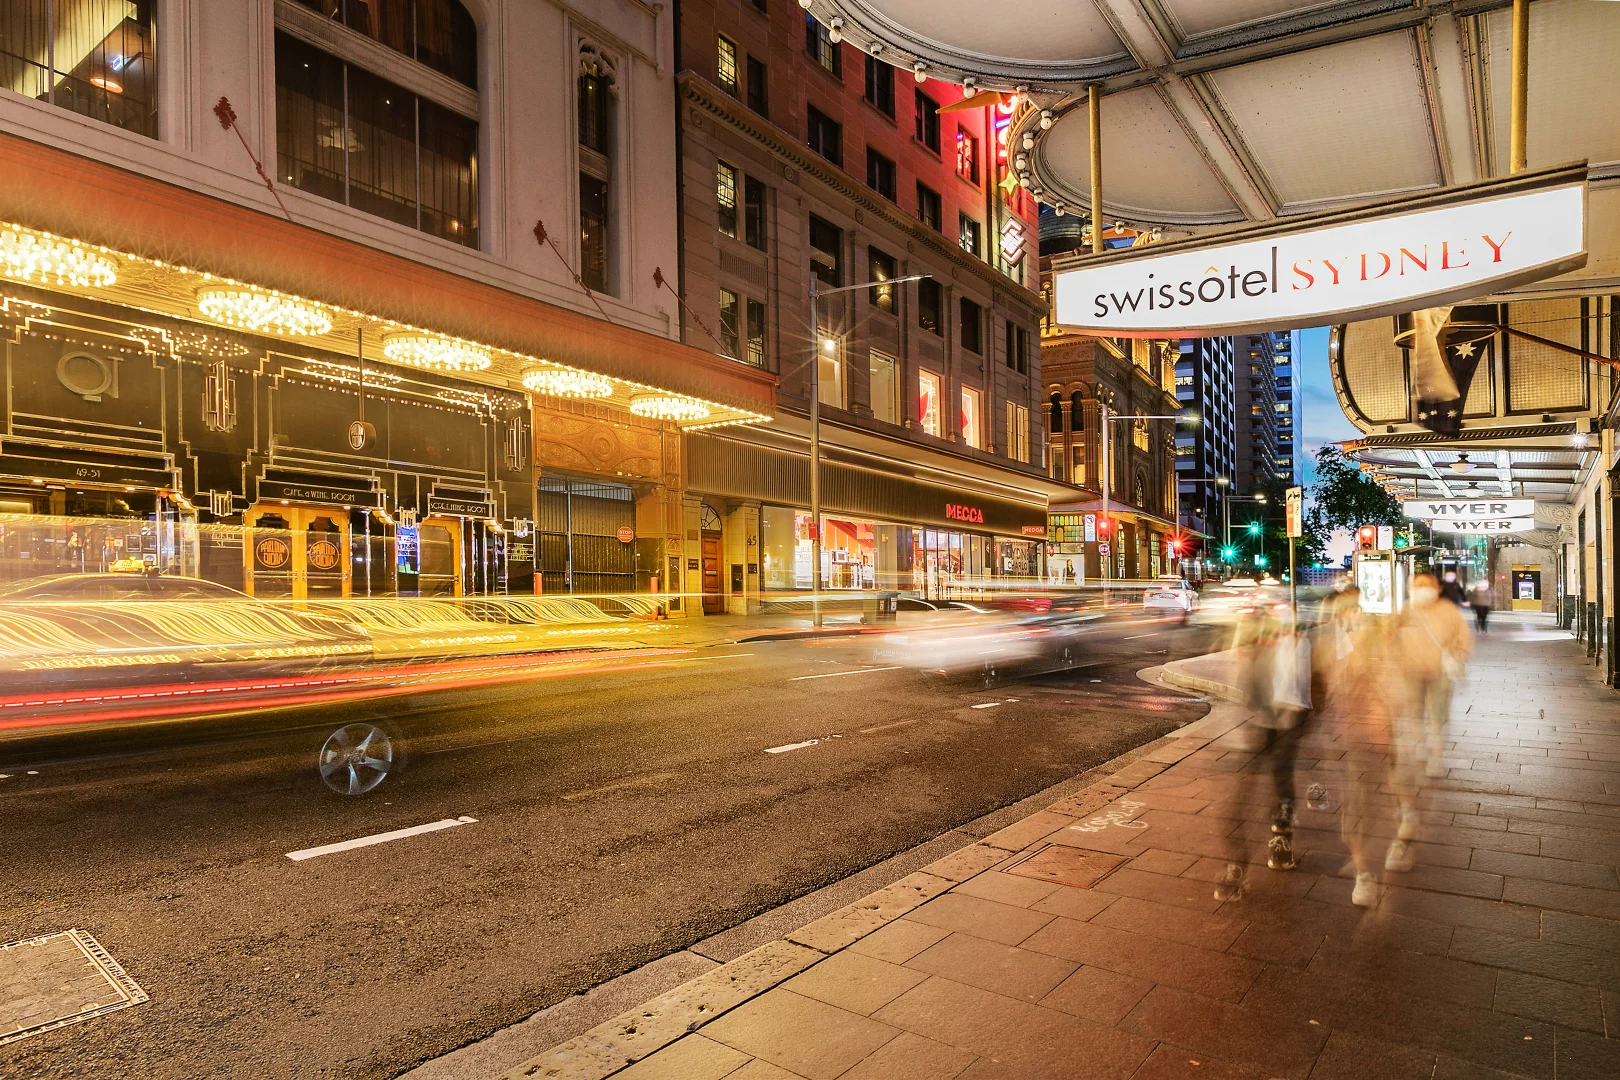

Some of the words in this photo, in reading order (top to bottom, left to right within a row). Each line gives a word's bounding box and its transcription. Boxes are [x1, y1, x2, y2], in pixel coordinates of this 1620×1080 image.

[1094, 246, 1278, 318] swissôtel
[1292, 231, 1512, 290] SYDNEY
[331, 492, 355, 501] ROOM
[467, 505, 486, 514] ROOM
[946, 504, 984, 523] MECCA
[1428, 504, 1508, 514] MYER
[747, 535, 757, 545] 45
